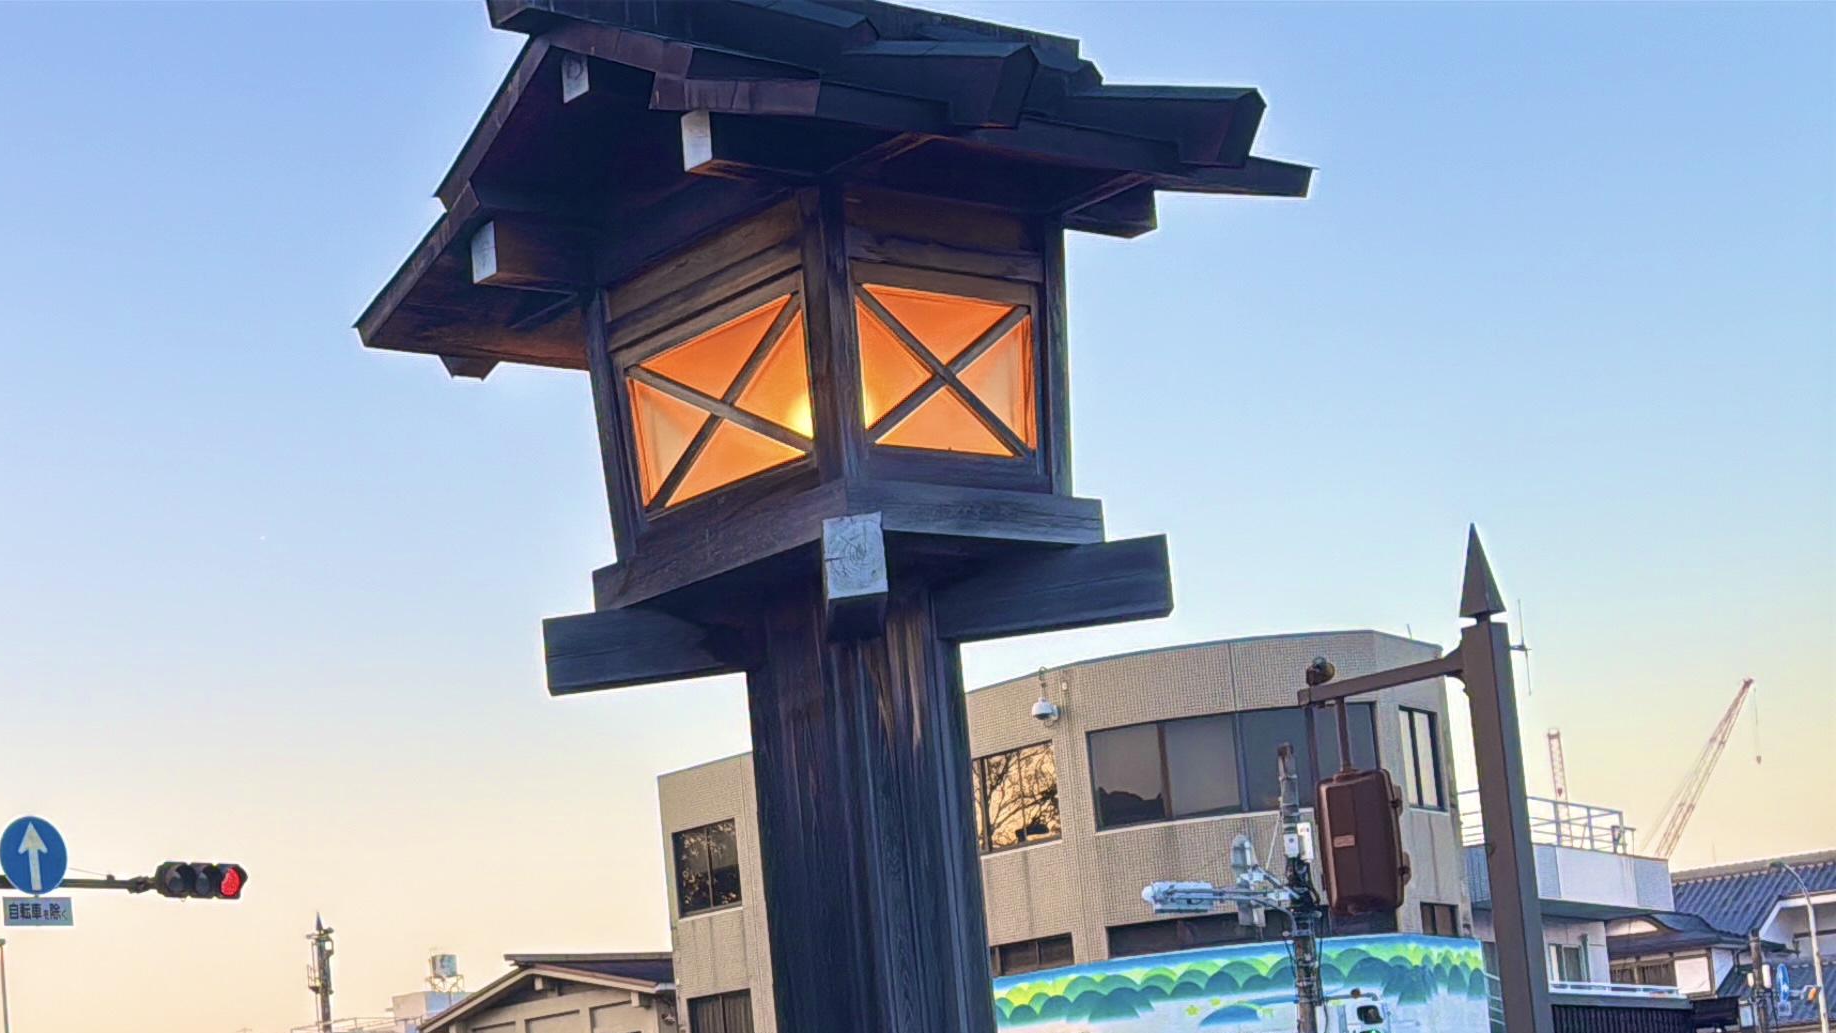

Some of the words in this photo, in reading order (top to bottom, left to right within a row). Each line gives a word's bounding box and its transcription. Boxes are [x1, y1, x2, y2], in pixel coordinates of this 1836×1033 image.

[8, 903, 68, 921] 自転車を除く
